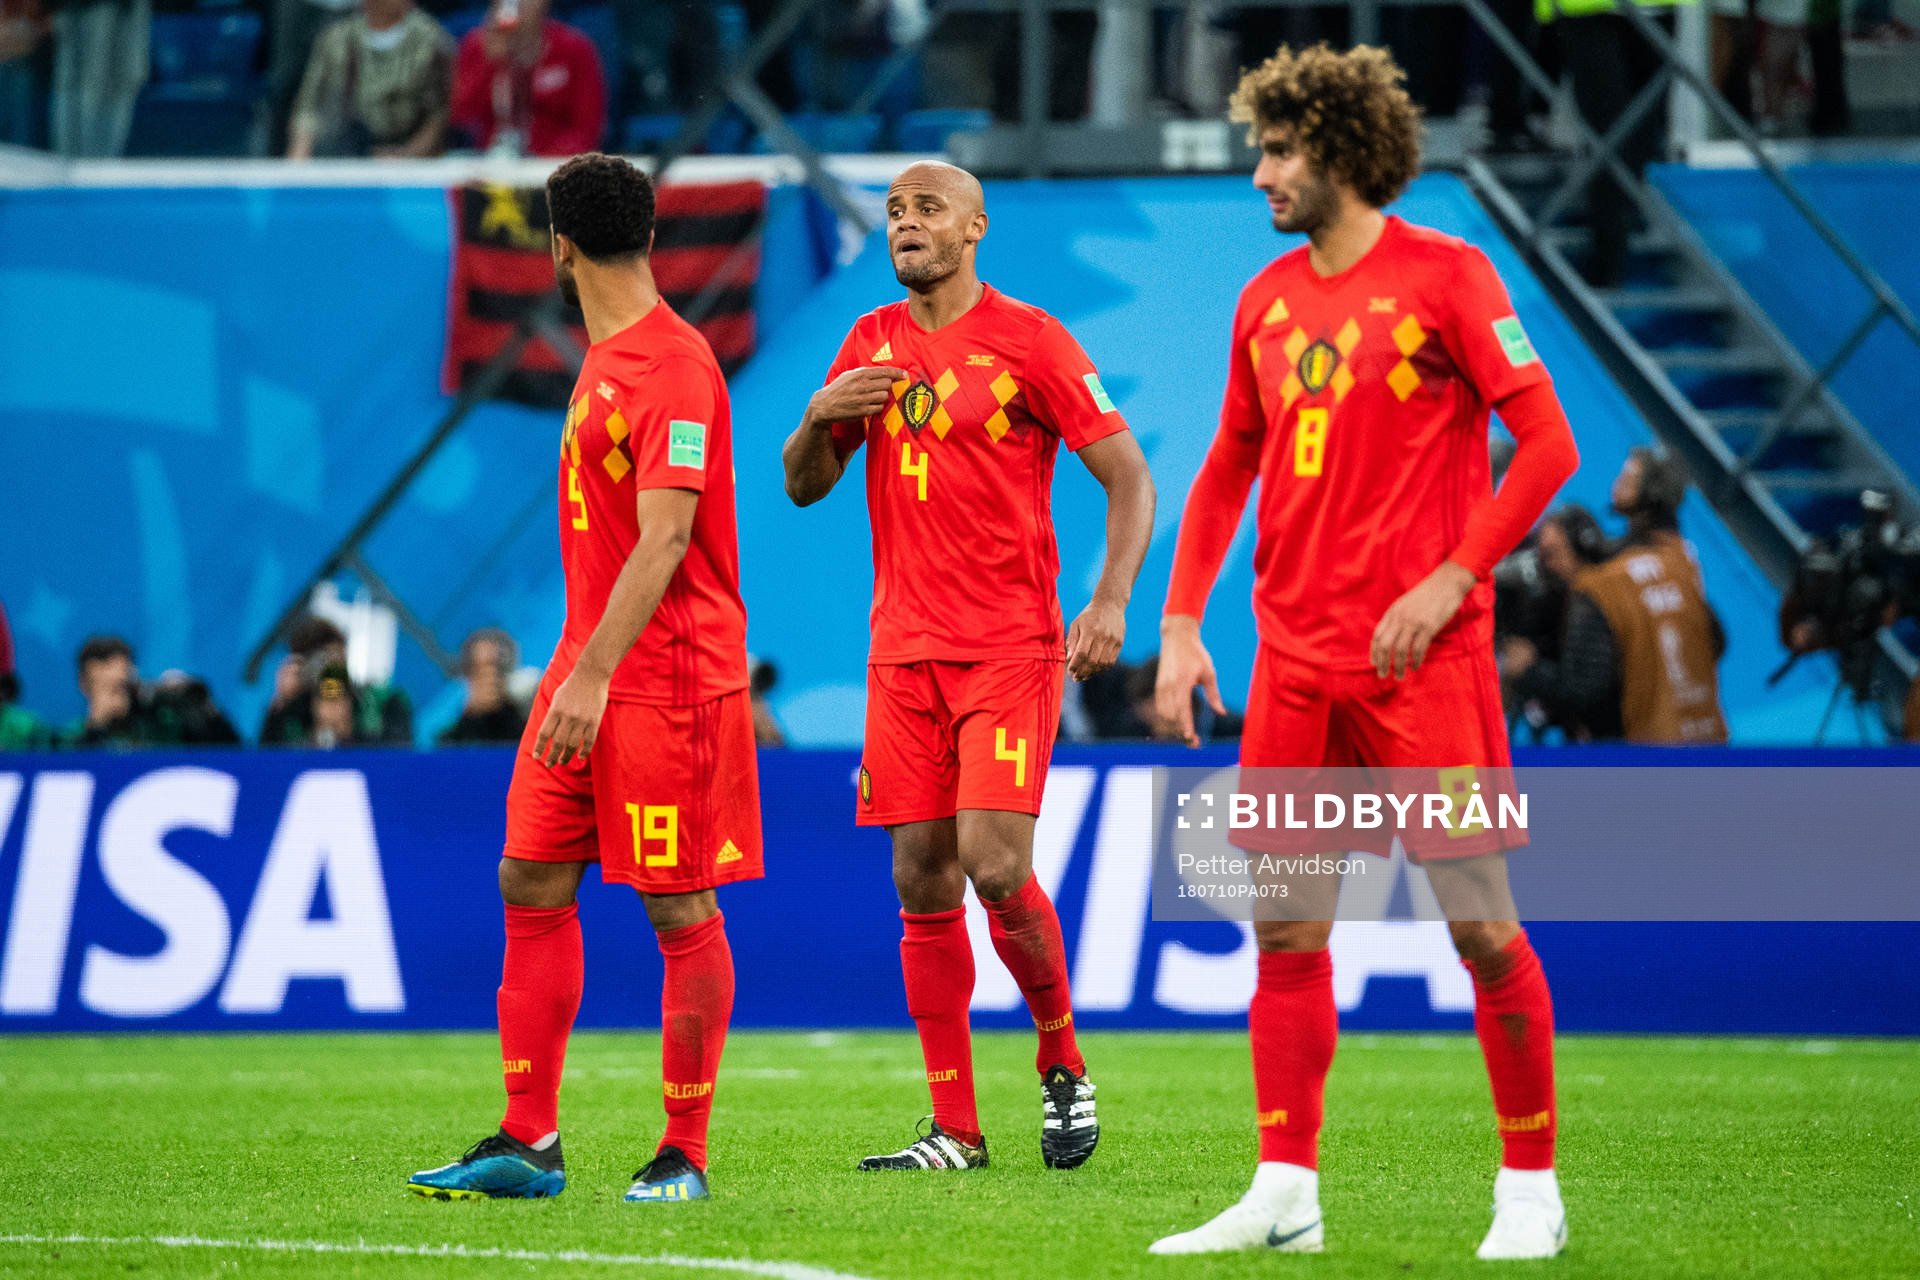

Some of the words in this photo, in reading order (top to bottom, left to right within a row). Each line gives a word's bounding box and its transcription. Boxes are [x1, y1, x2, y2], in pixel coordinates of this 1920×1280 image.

[901, 442, 928, 501] 4
[1294, 407, 1328, 476] 8
[995, 727, 1026, 787] 4
[625, 801, 678, 867] 19
